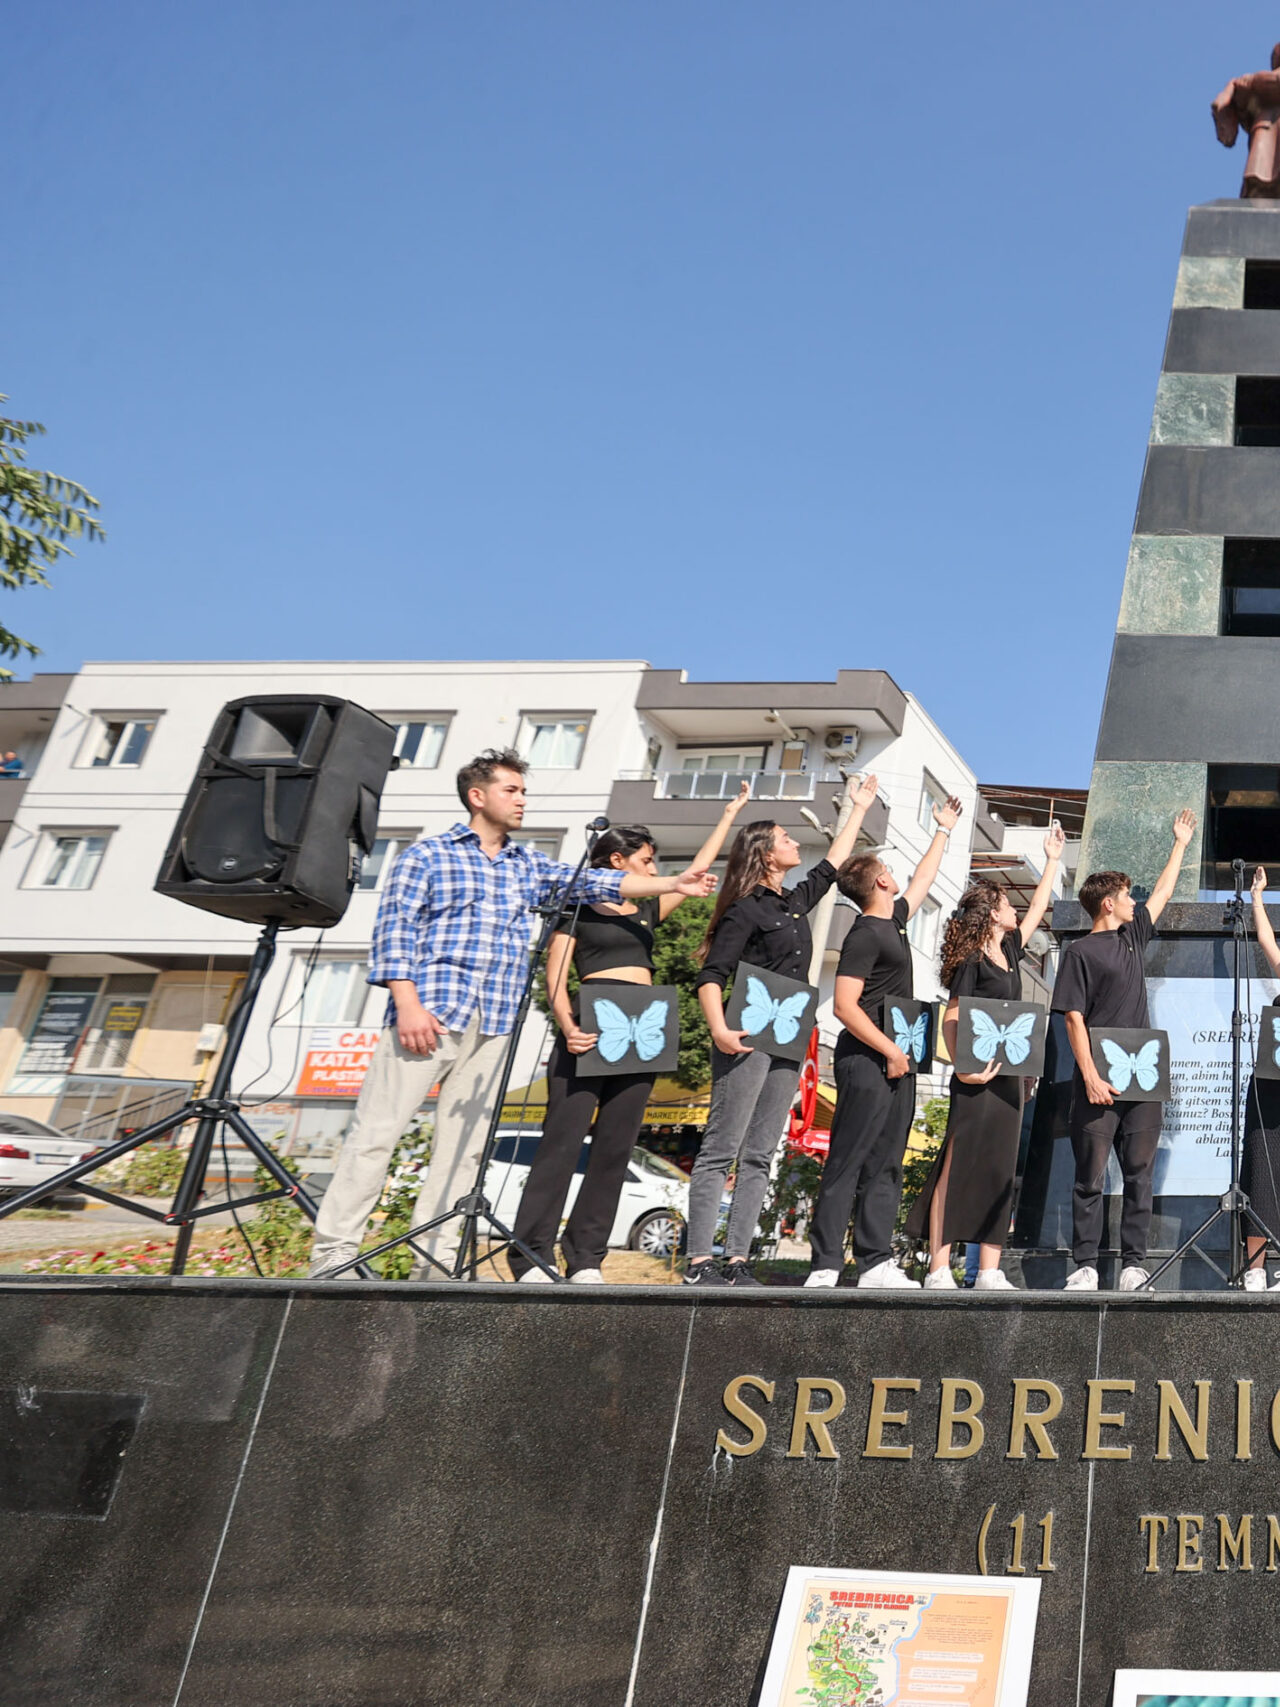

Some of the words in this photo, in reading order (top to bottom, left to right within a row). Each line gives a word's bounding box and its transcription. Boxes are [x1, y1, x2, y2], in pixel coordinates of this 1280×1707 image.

[309, 1053, 371, 1068] KATLA
[977, 1502, 1056, 1575] (11
[829, 1590, 915, 1605] SREBRENICA
